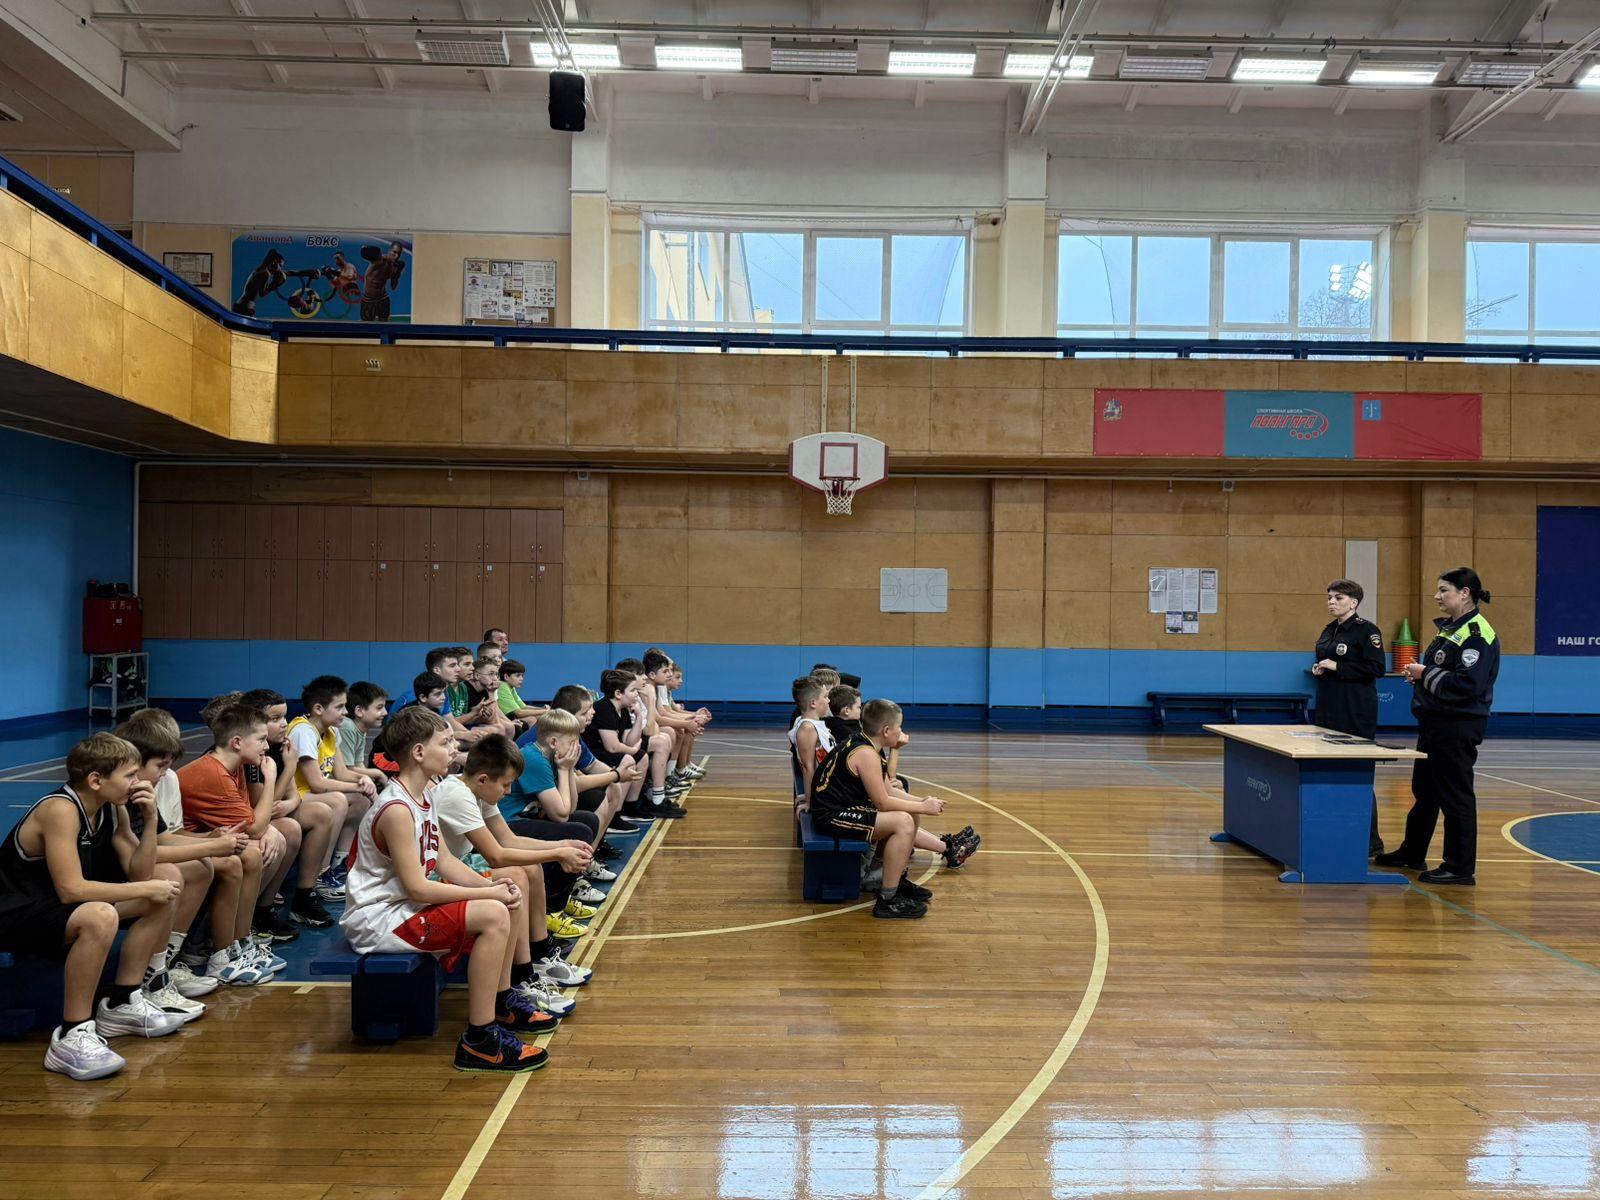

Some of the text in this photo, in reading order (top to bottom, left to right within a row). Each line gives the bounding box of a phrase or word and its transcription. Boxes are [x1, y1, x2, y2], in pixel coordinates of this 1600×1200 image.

[307, 235, 339, 247] БОКС
[1250, 415, 1318, 428] АВАНГАРД
[1557, 636, 1585, 645] НАШ
